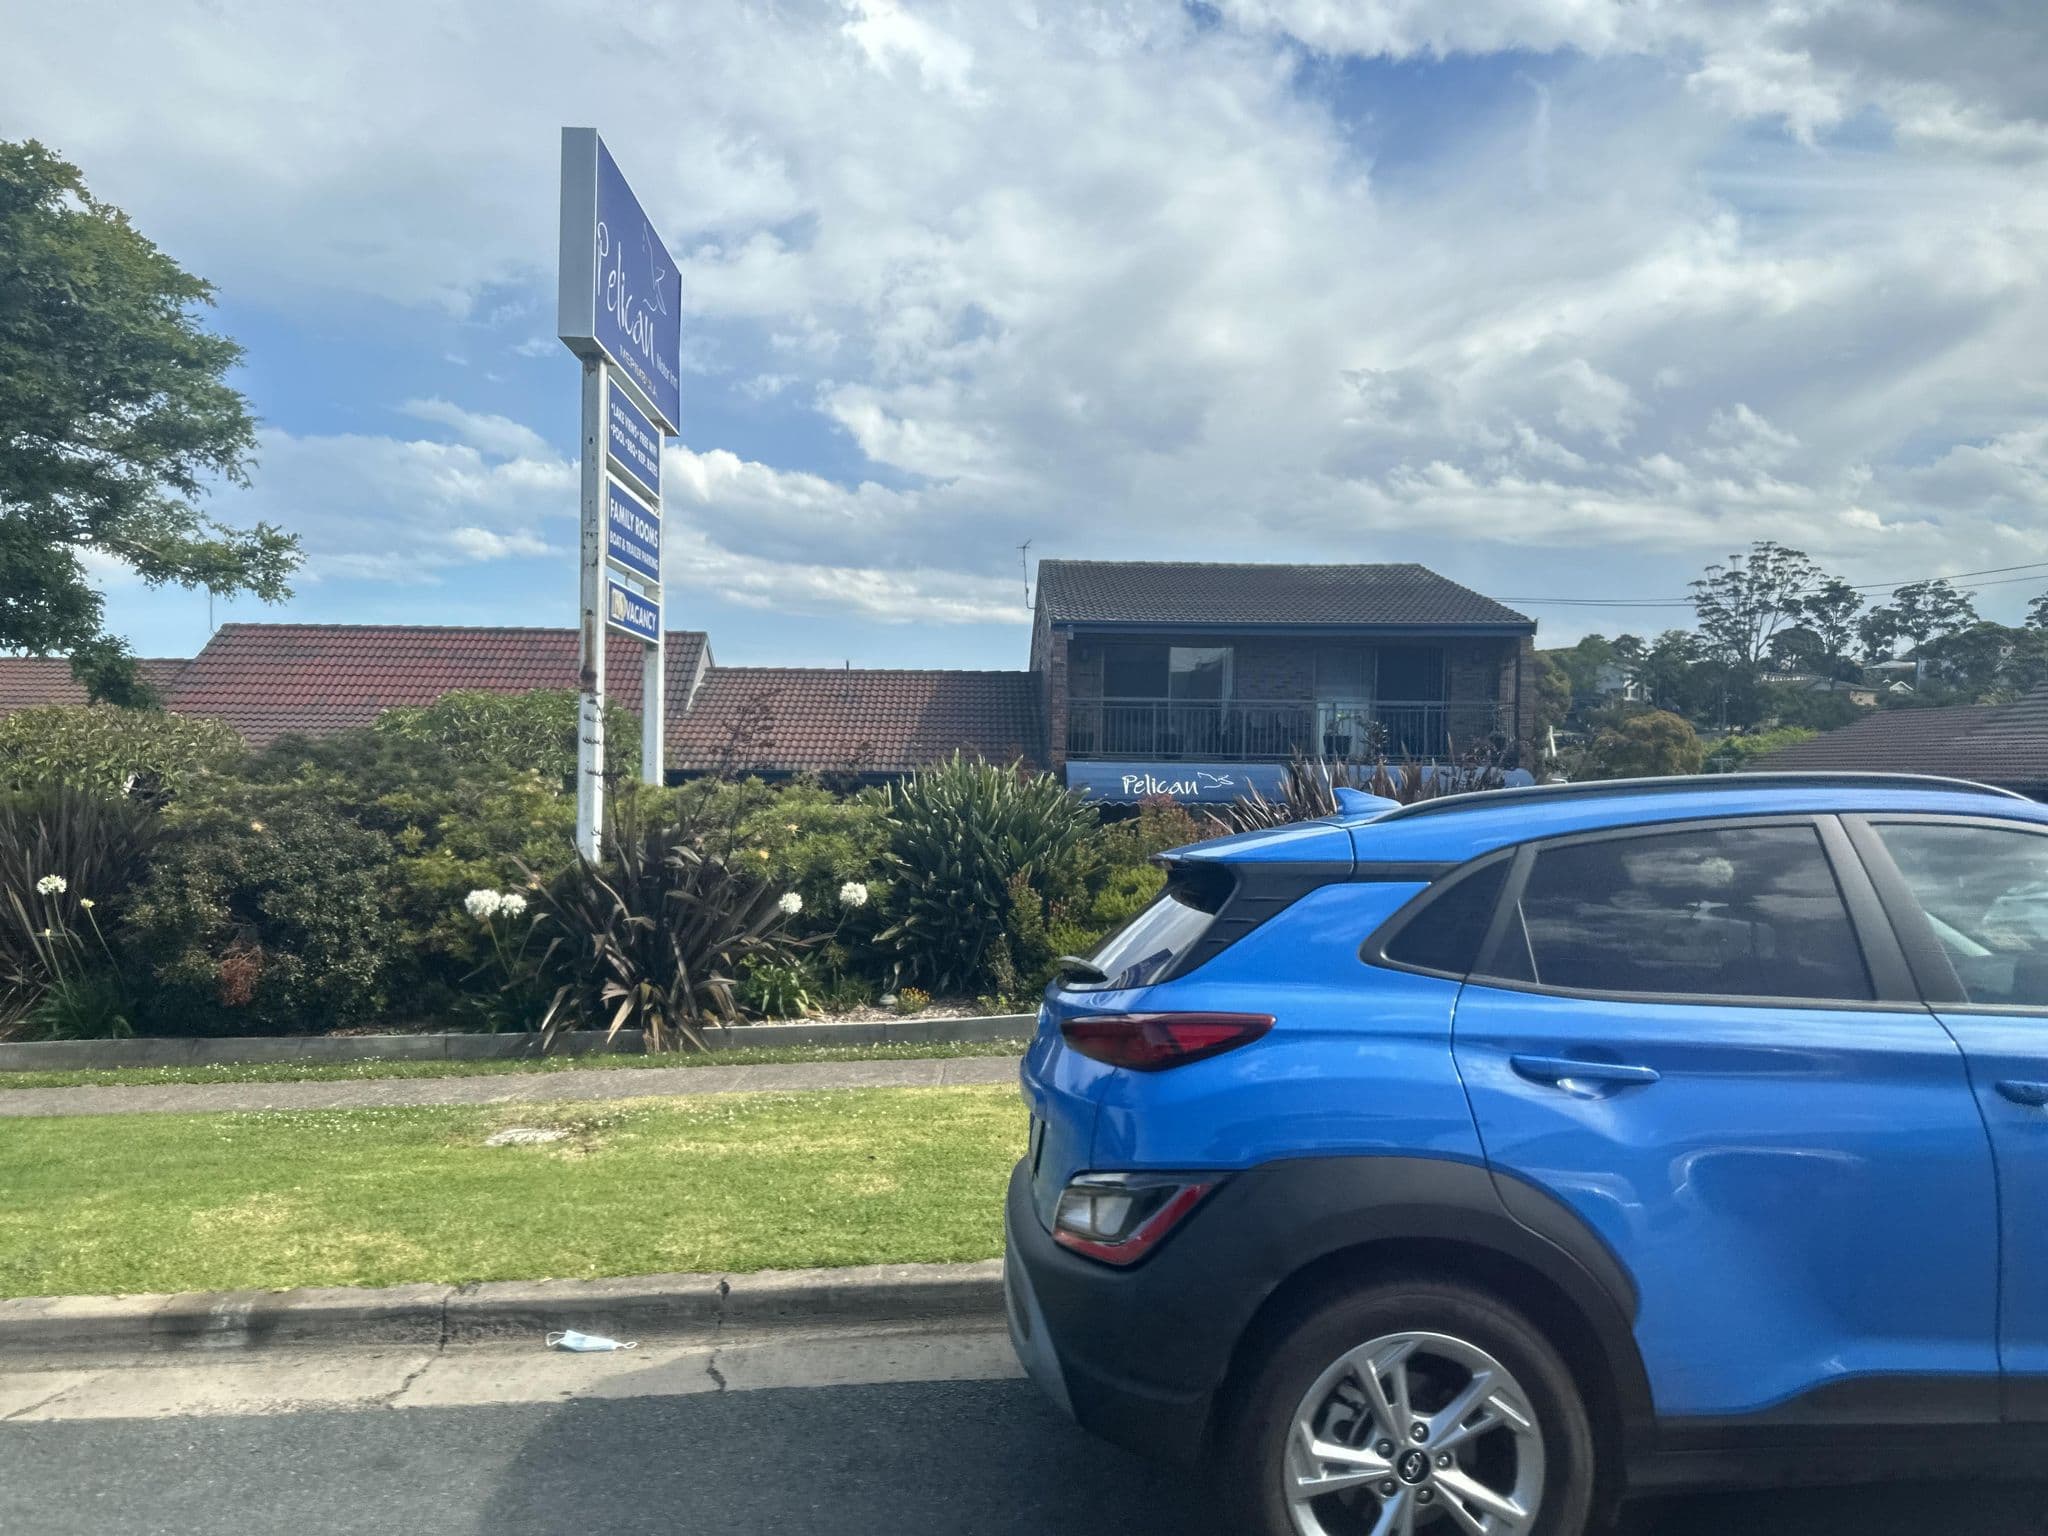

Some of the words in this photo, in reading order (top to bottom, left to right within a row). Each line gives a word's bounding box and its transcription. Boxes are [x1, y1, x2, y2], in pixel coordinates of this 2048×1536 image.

[597, 221, 655, 368] Pelican
[609, 530, 622, 549] BOAT
[610, 497, 635, 532] FAMILY
[635, 515, 659, 549] ROOMS
[626, 600, 657, 633] VACANCY
[1121, 773, 1200, 796] Pelican
